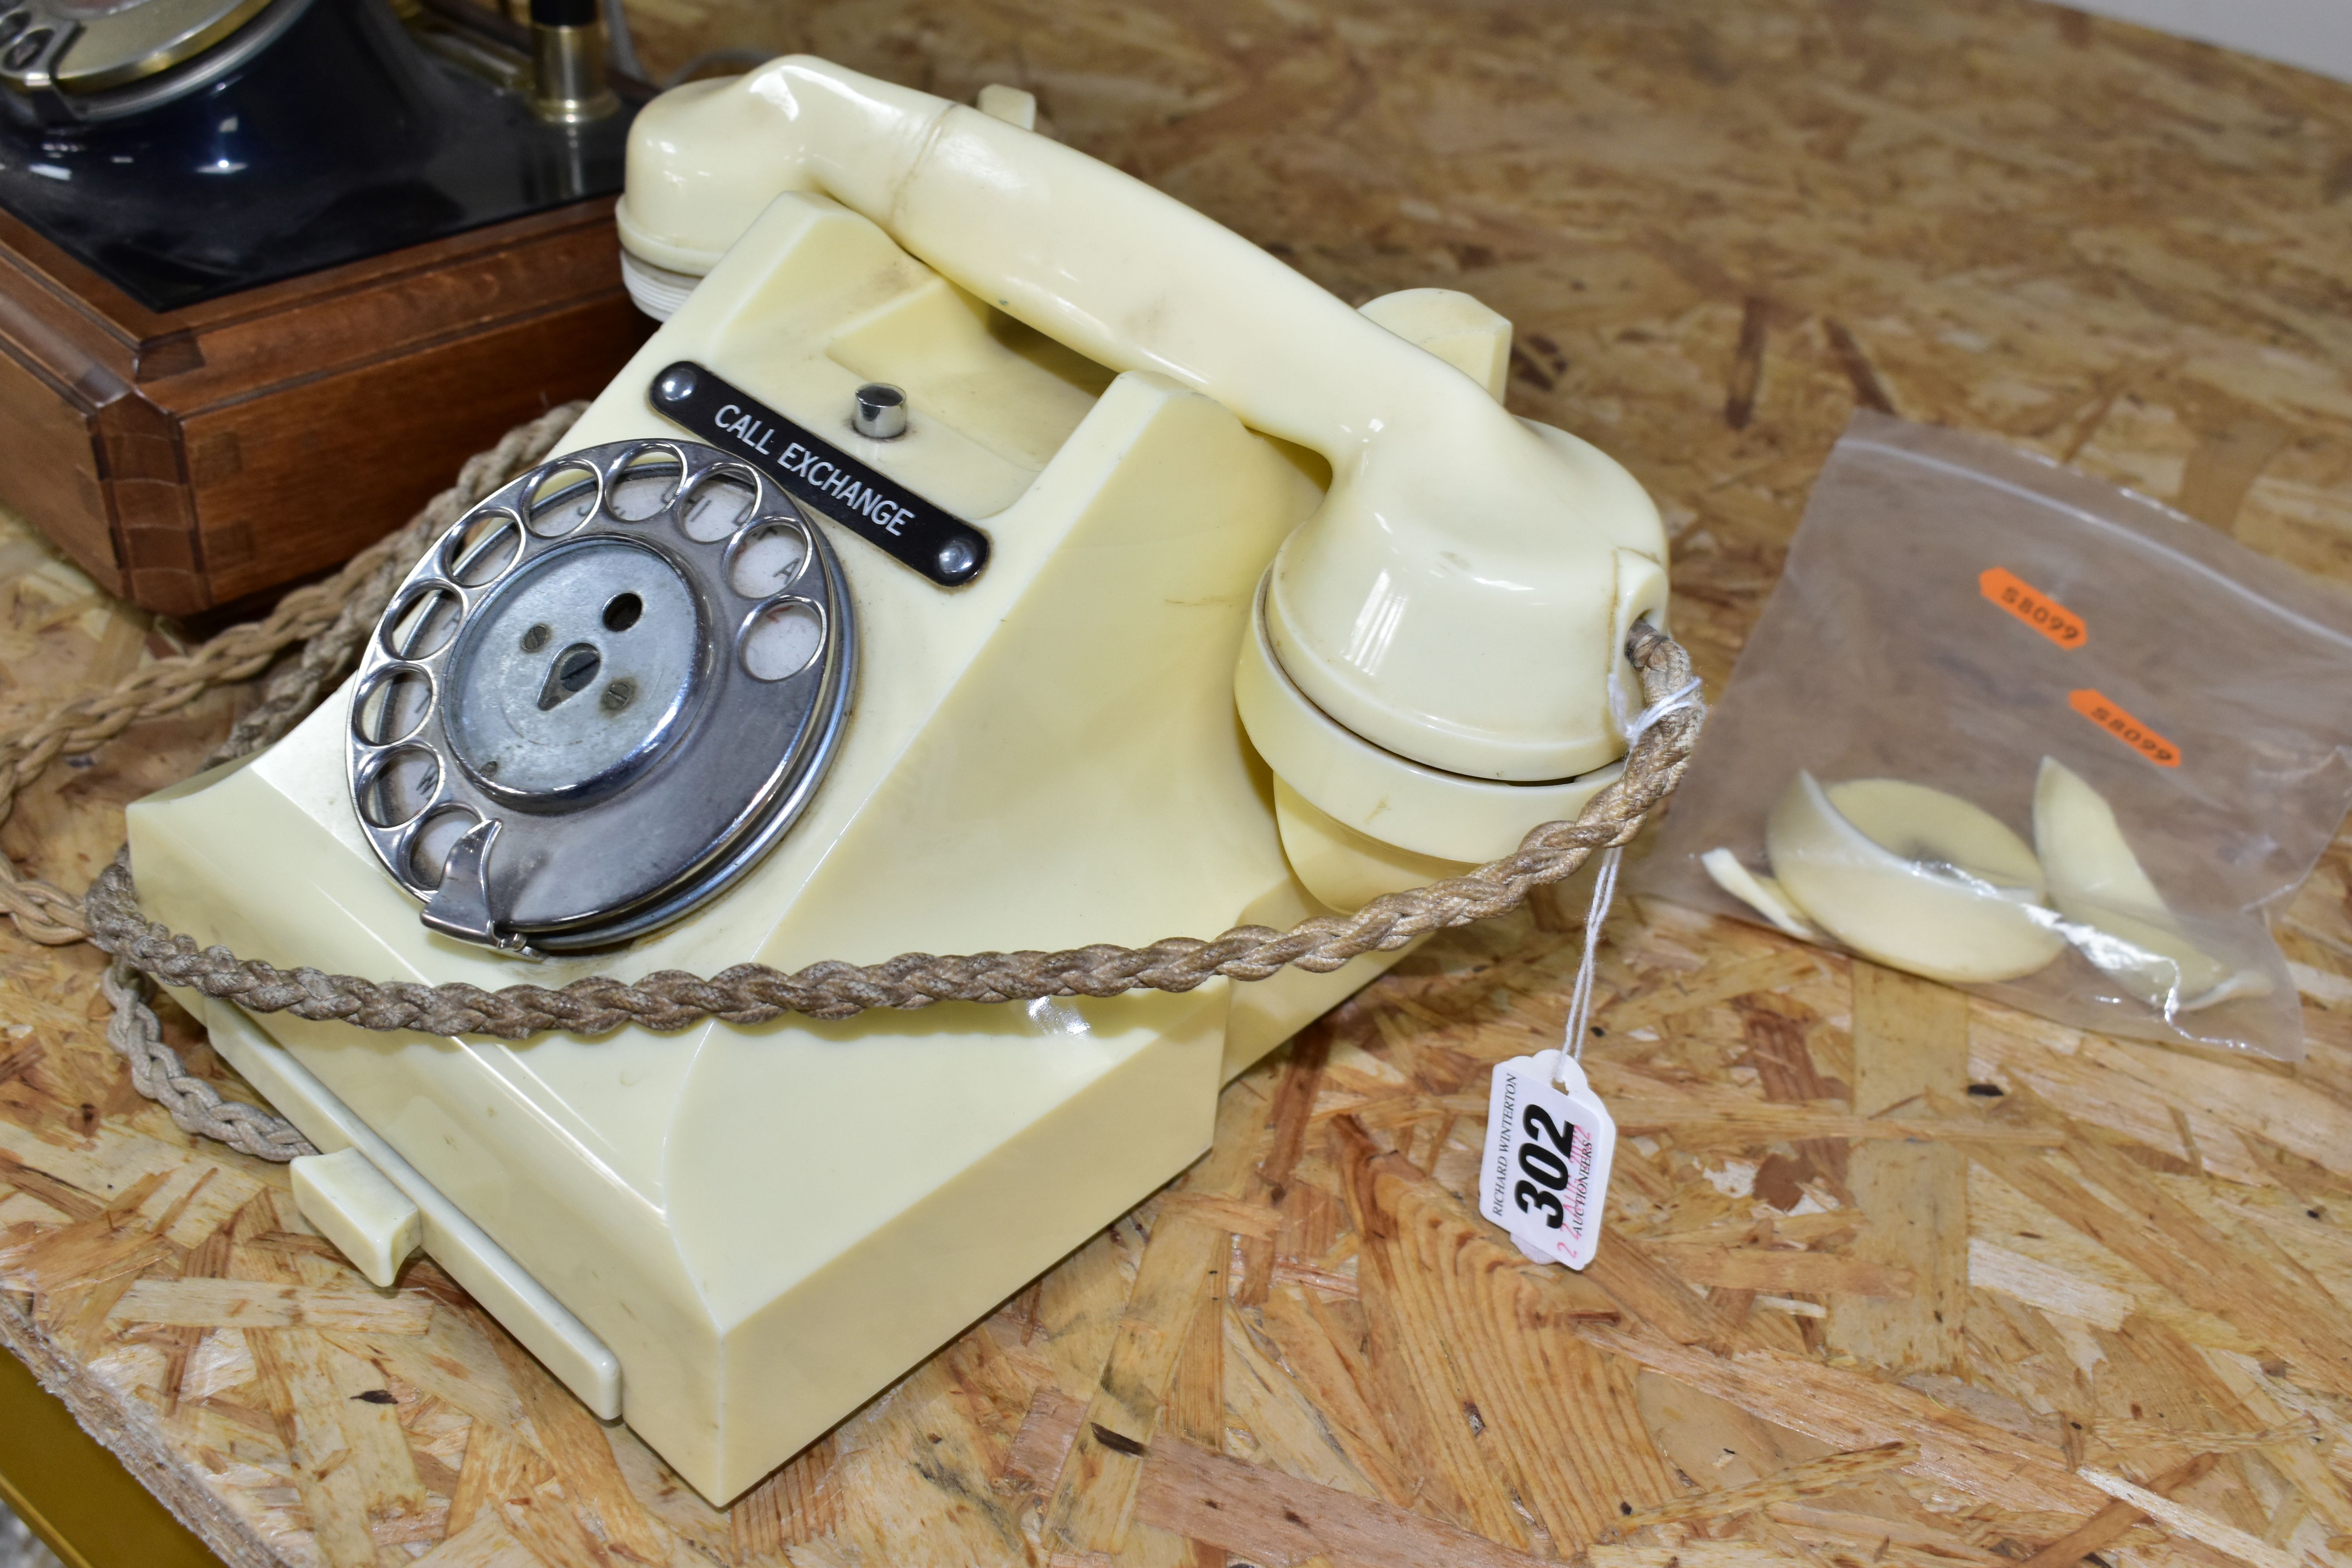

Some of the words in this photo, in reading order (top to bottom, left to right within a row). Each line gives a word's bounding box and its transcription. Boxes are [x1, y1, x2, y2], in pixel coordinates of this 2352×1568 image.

[714, 405, 775, 455] CALL
[777, 443, 916, 537] EXCHANGE
[1499, 1073, 1517, 1152] WINTERTON
[1493, 1156, 1508, 1216] RICHARD
[1514, 1104, 1575, 1229] 302
[1573, 1140, 1592, 1236] AUCTIONEERS
